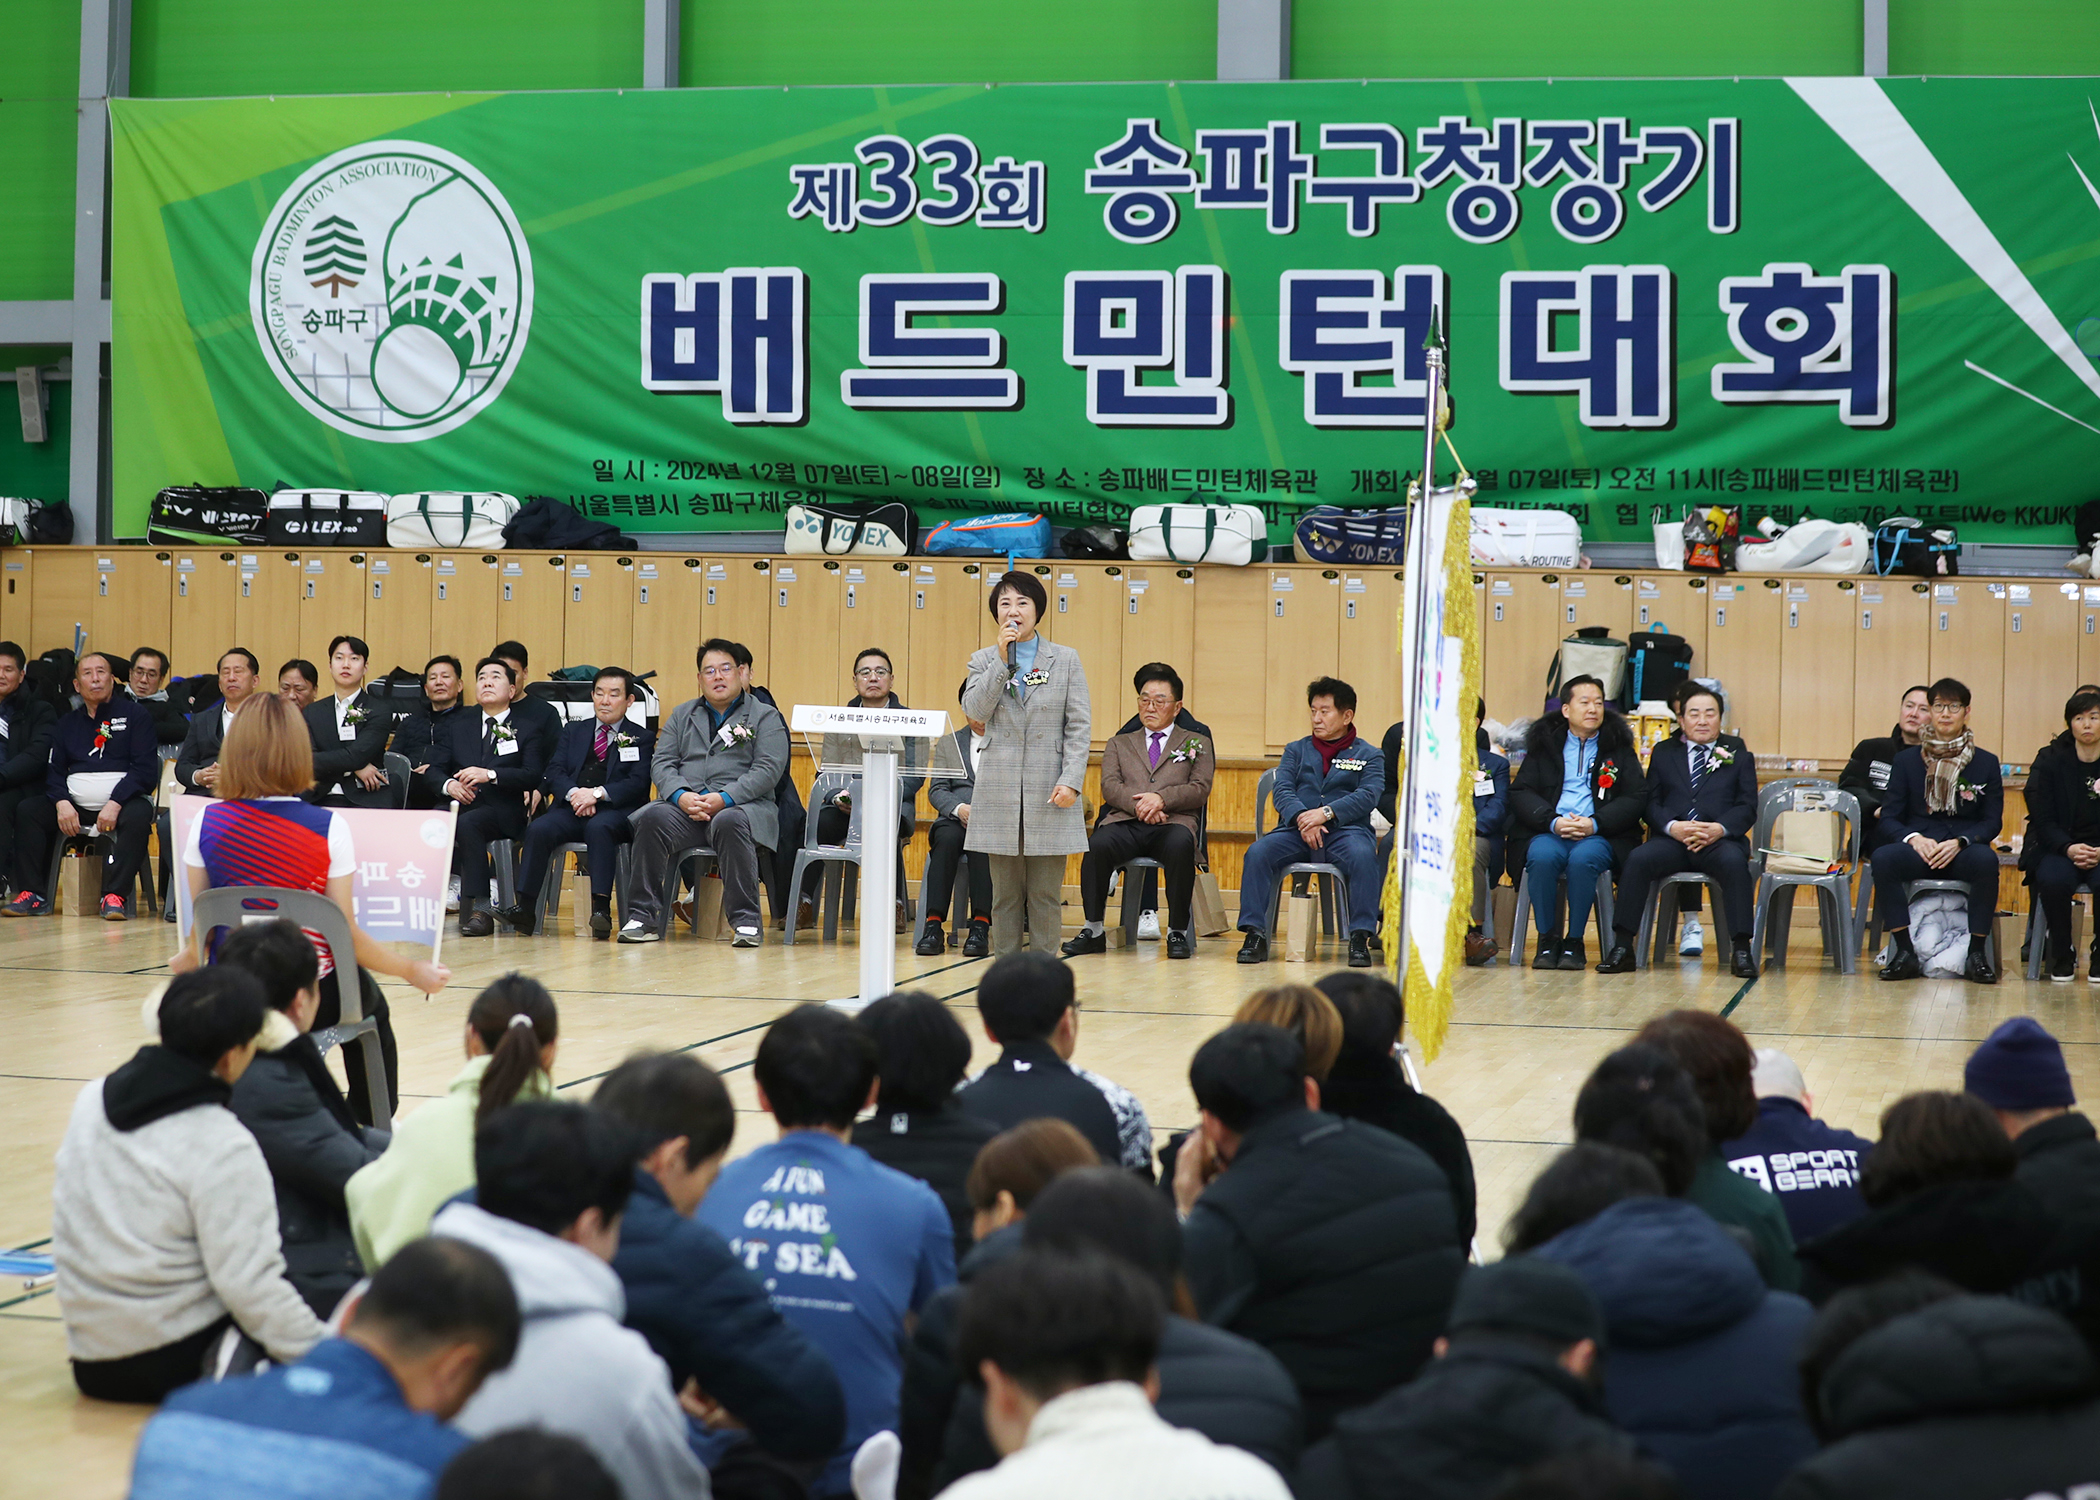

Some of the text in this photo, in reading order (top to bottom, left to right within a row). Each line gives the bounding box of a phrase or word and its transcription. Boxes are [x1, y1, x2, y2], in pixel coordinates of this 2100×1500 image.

[788, 117, 1738, 243] 제33회 송파구청장기
[268, 161, 439, 360] SONGPAGU BADMINTON ASSOCIATION
[302, 309, 368, 333] 송파구
[641, 262, 1891, 427] 배드민턴대회
[668, 461, 742, 481] 2024년
[750, 462, 797, 484] 12월
[1099, 467, 1318, 494] 송파배드민턴체육관
[1508, 468, 1600, 490] 07일(토)
[1609, 467, 1656, 492] 오전
[1667, 467, 1959, 494] 11시(송파배드민턴체육관)
[570, 494, 680, 517] 서울특별시
[1531, 555, 1573, 567] ROUTINE
[829, 713, 927, 725] 서울특별시송파구체육회
[1769, 1149, 1858, 1173] SPORT
[743, 1199, 831, 1235] GAME
[774, 1241, 857, 1281] SEA
